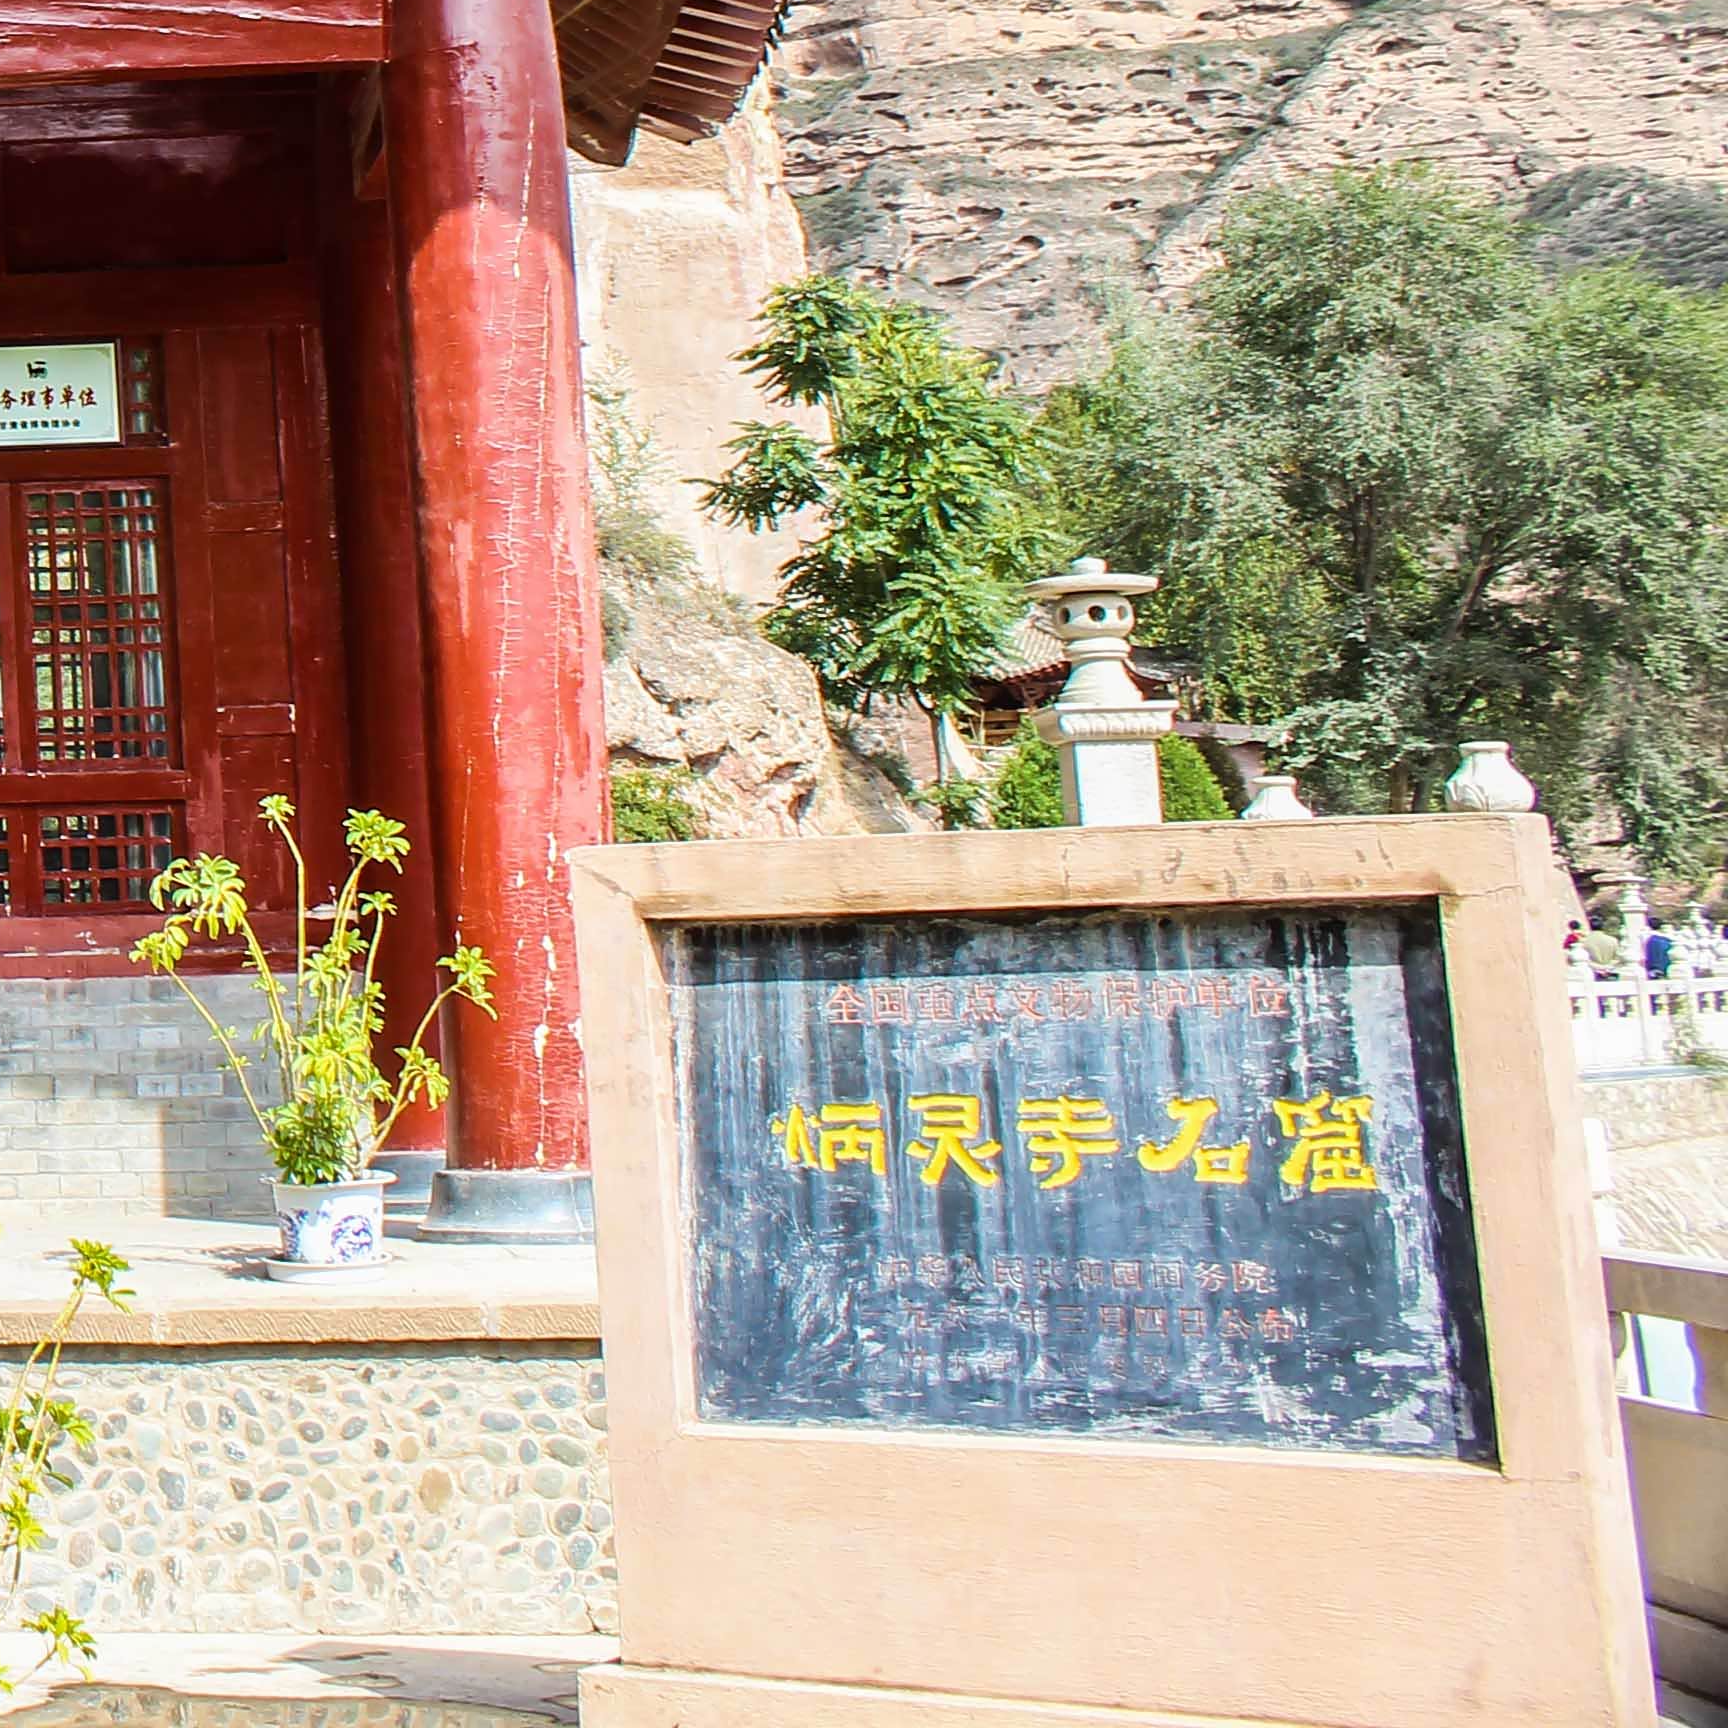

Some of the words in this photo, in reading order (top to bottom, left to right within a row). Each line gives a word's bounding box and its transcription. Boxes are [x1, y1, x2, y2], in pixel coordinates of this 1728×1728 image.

[825, 974, 1291, 1027] 全国重点文物保护单位
[771, 1089, 1380, 1193] 炳灵寺石窟
[877, 1254, 1278, 1295] 中华人民共和国国务院
[861, 1300, 1295, 1343] 一九六一年三月四日公布
